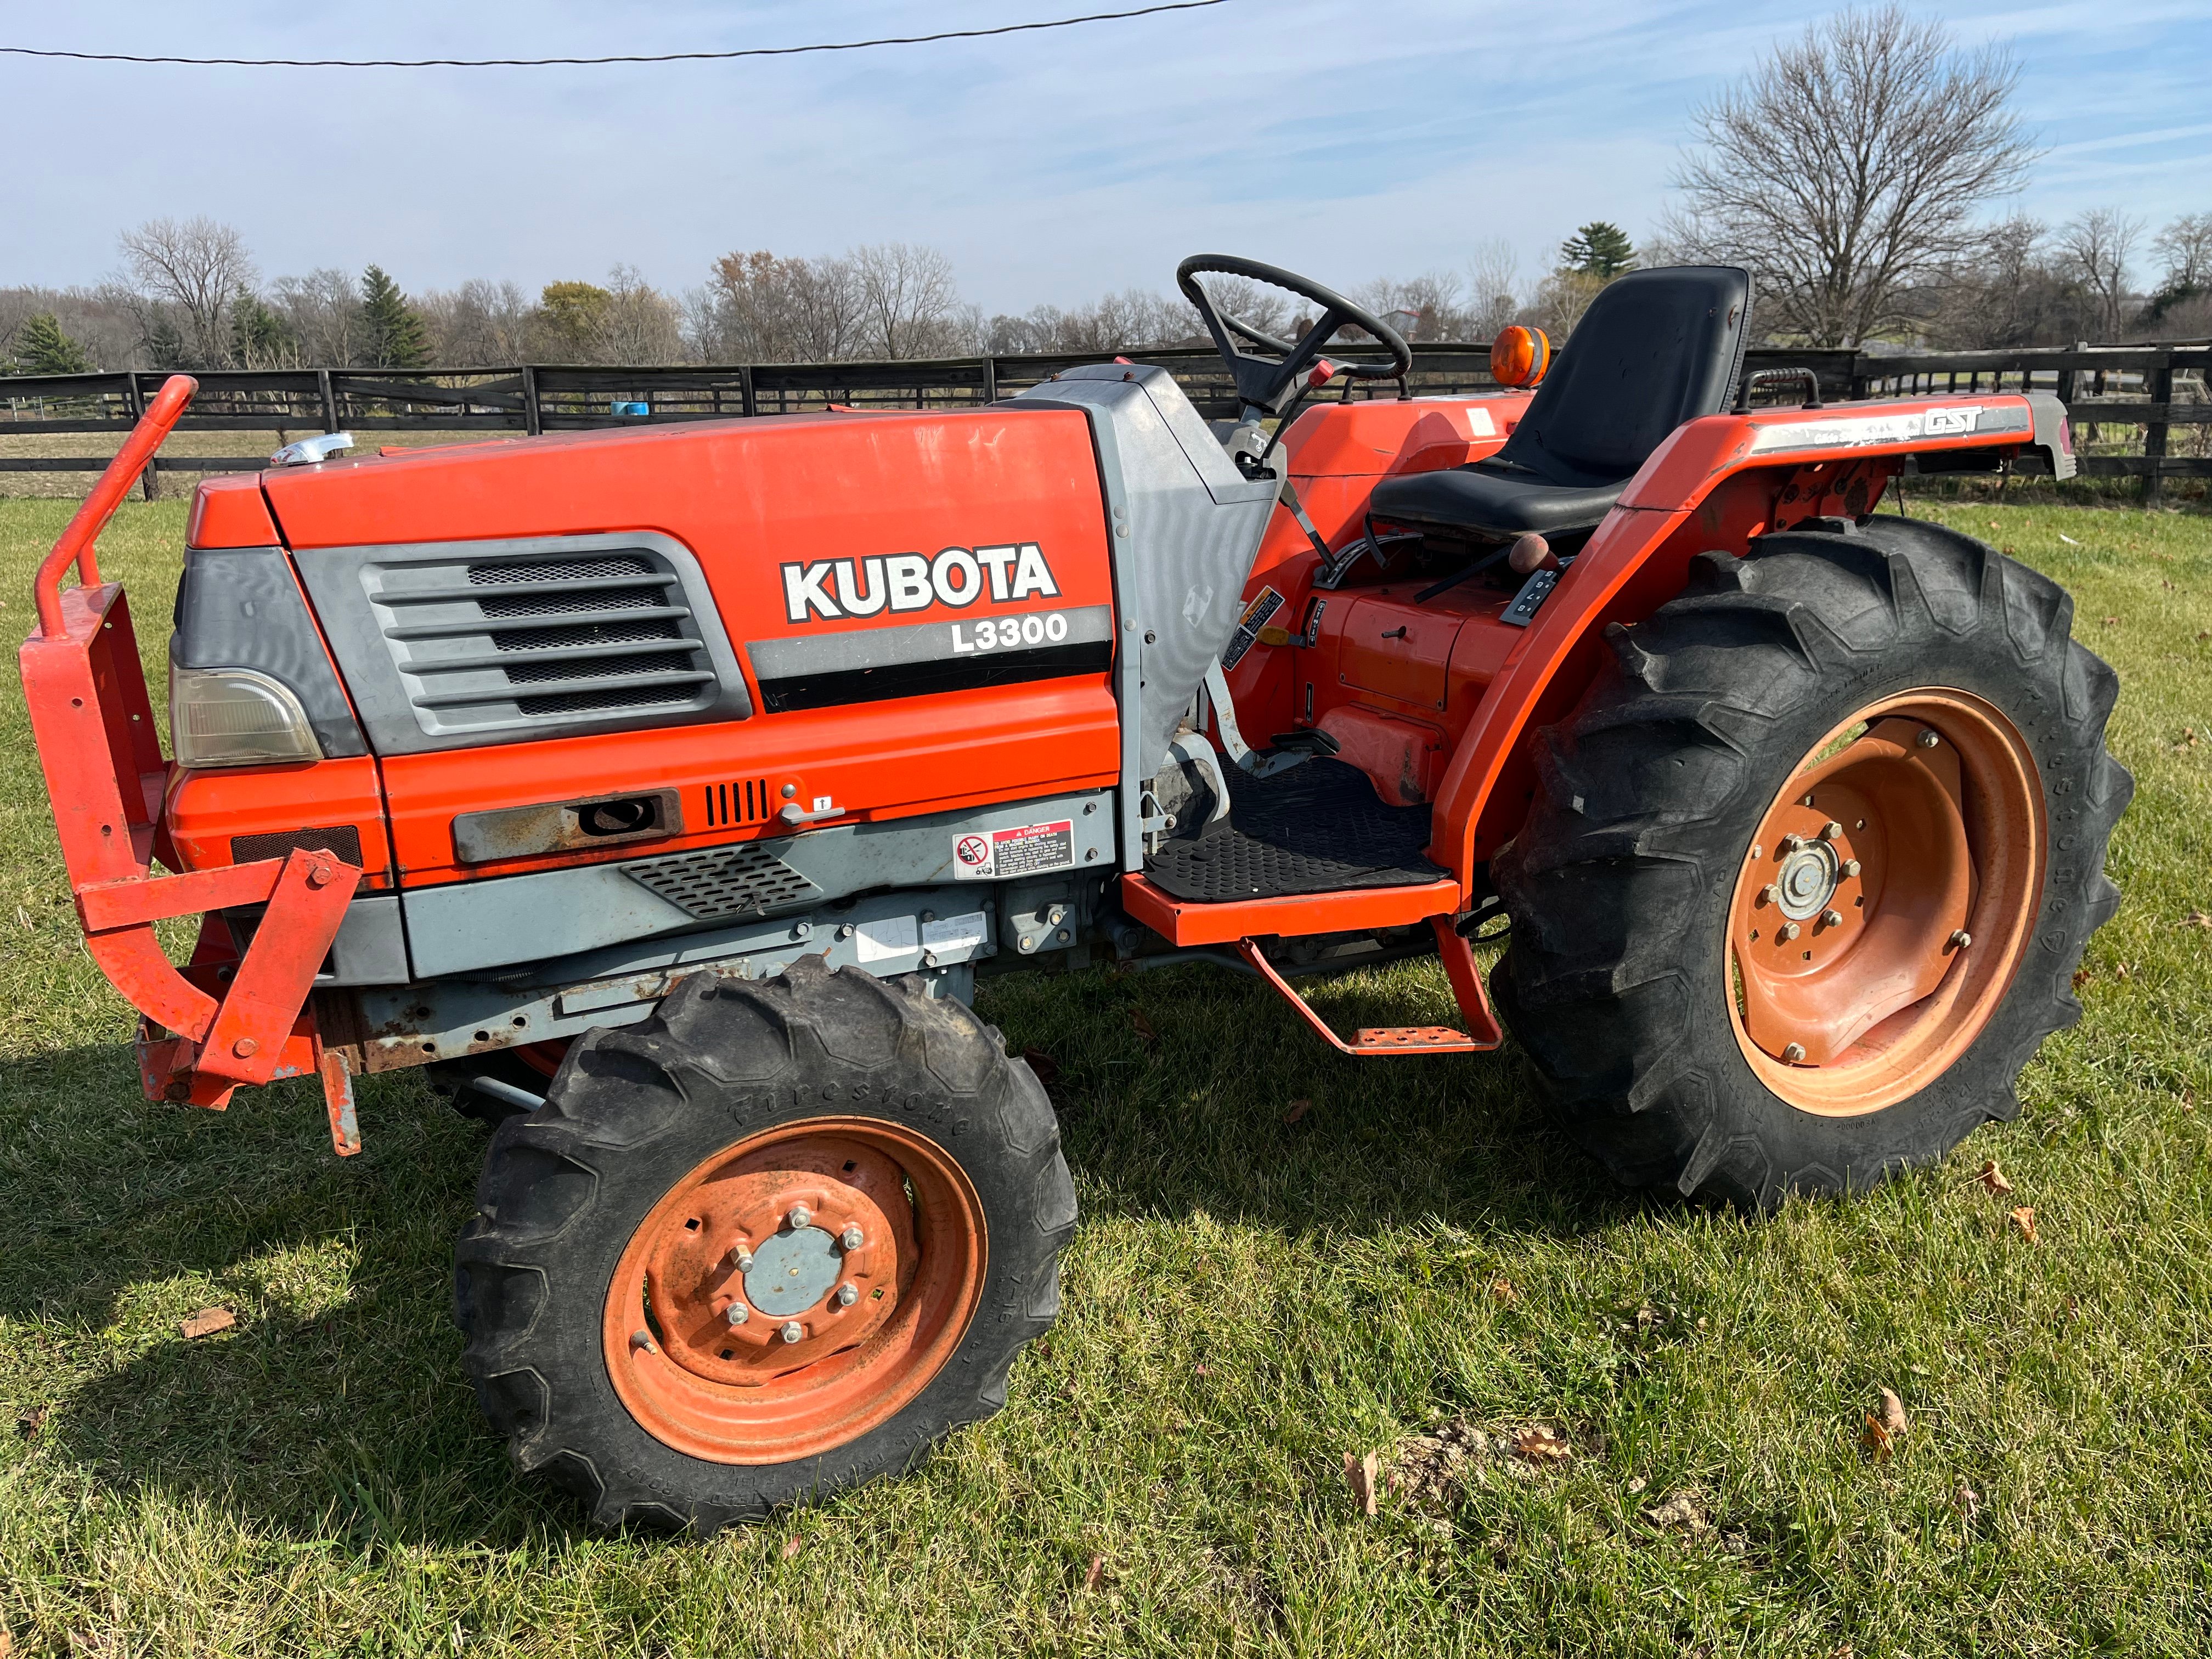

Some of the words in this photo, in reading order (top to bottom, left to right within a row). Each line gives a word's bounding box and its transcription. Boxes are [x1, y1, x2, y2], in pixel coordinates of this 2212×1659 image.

[1924, 405, 1983, 436] GST
[780, 541, 1062, 624] KUBOTA
[951, 613, 1068, 653] L3300
[1024, 826, 1049, 834] DANGER
[727, 1081, 972, 1137] Firestone
[997, 1273, 1025, 1324] 7-16
